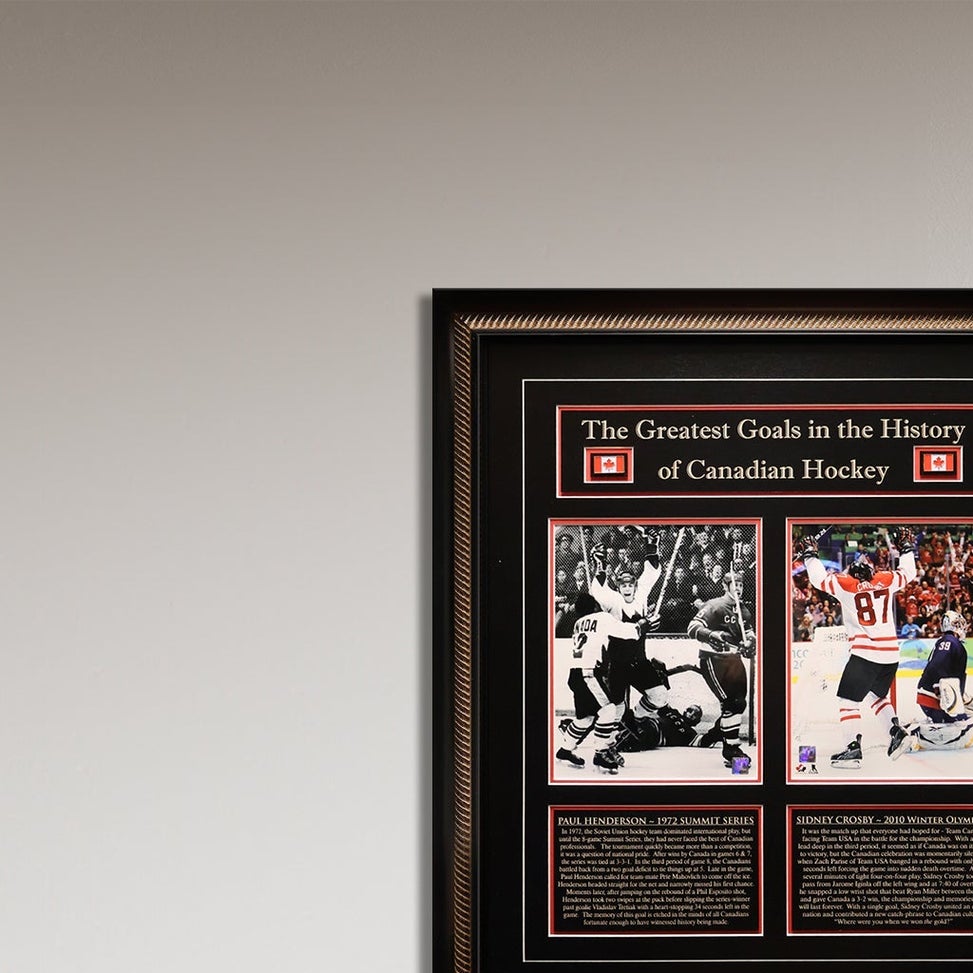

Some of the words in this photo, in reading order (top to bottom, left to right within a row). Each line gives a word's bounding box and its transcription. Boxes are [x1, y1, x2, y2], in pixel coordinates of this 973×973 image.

[580, 419, 629, 440] The
[635, 418, 731, 440] Greatest
[736, 419, 802, 440] Goals
[807, 419, 831, 439] in
[837, 418, 874, 439] the
[879, 418, 967, 445] History
[657, 459, 683, 480] of
[686, 459, 795, 480] Canadian
[801, 458, 890, 486] Hockey
[854, 588, 890, 627] 87
[938, 641, 952, 651] 39
[557, 816, 583, 825] PAUL
[584, 816, 647, 825] HENDERSON
[657, 816, 678, 825] 1972
[679, 816, 721, 825] SUMMIT
[722, 816, 755, 825] SERIES
[796, 815, 834, 824] SIDNEY
[835, 815, 875, 824] CROSBY
[883, 815, 906, 824] 2010
